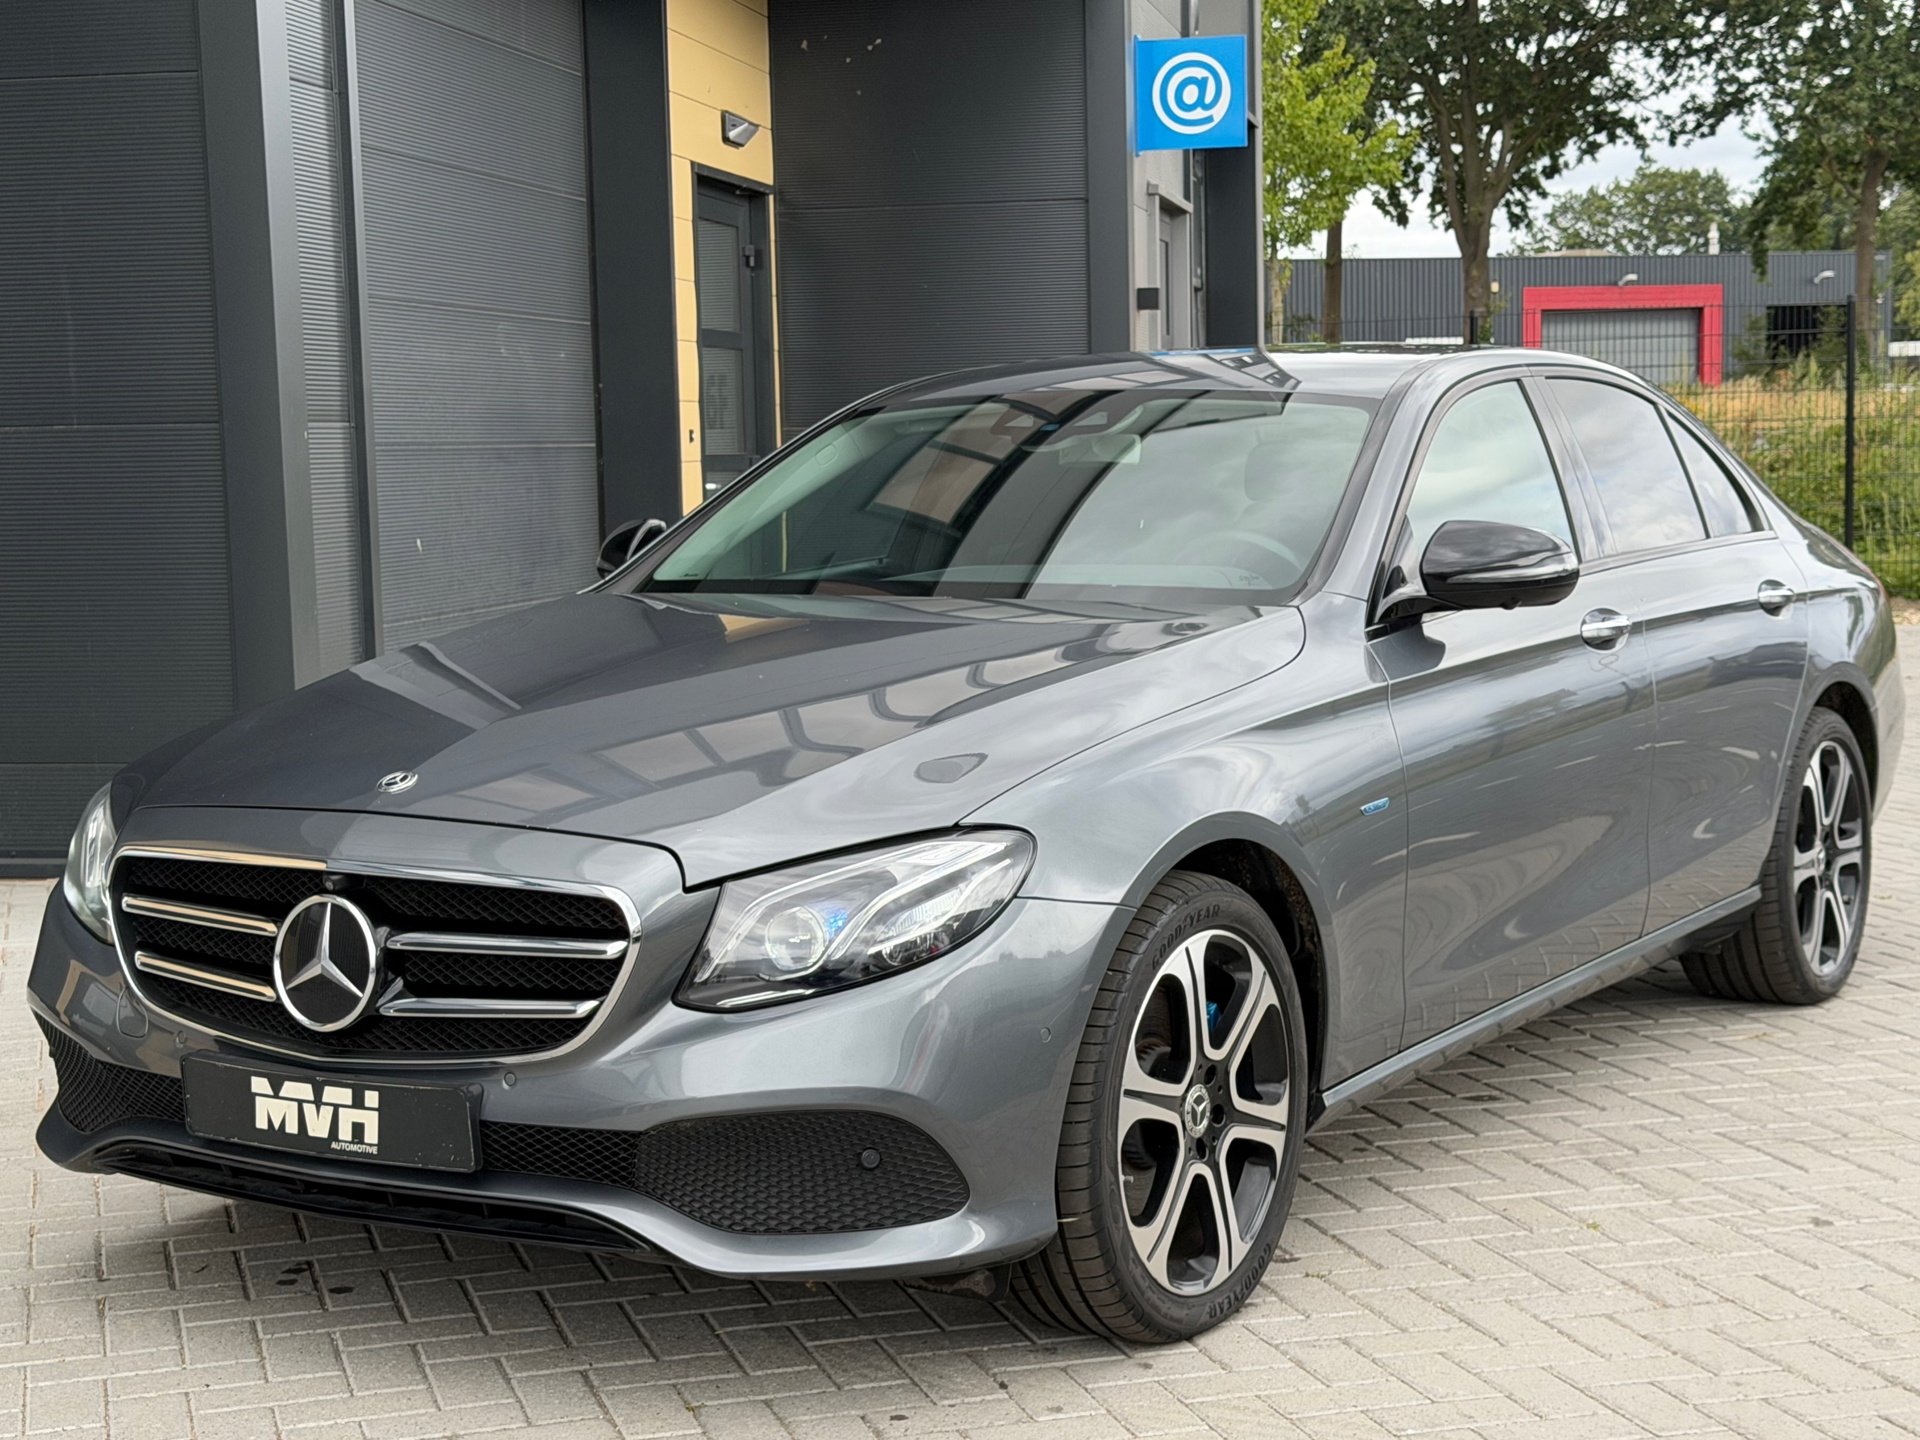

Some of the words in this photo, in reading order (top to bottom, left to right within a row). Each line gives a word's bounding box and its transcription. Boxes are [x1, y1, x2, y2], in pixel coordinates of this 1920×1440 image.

[1152, 903, 1221, 971] GOODYEAR
[251, 1075, 379, 1144] MVH
[330, 1141, 379, 1155] AUTOMOTIVE
[1208, 1243, 1272, 1319] GOODYEAR
